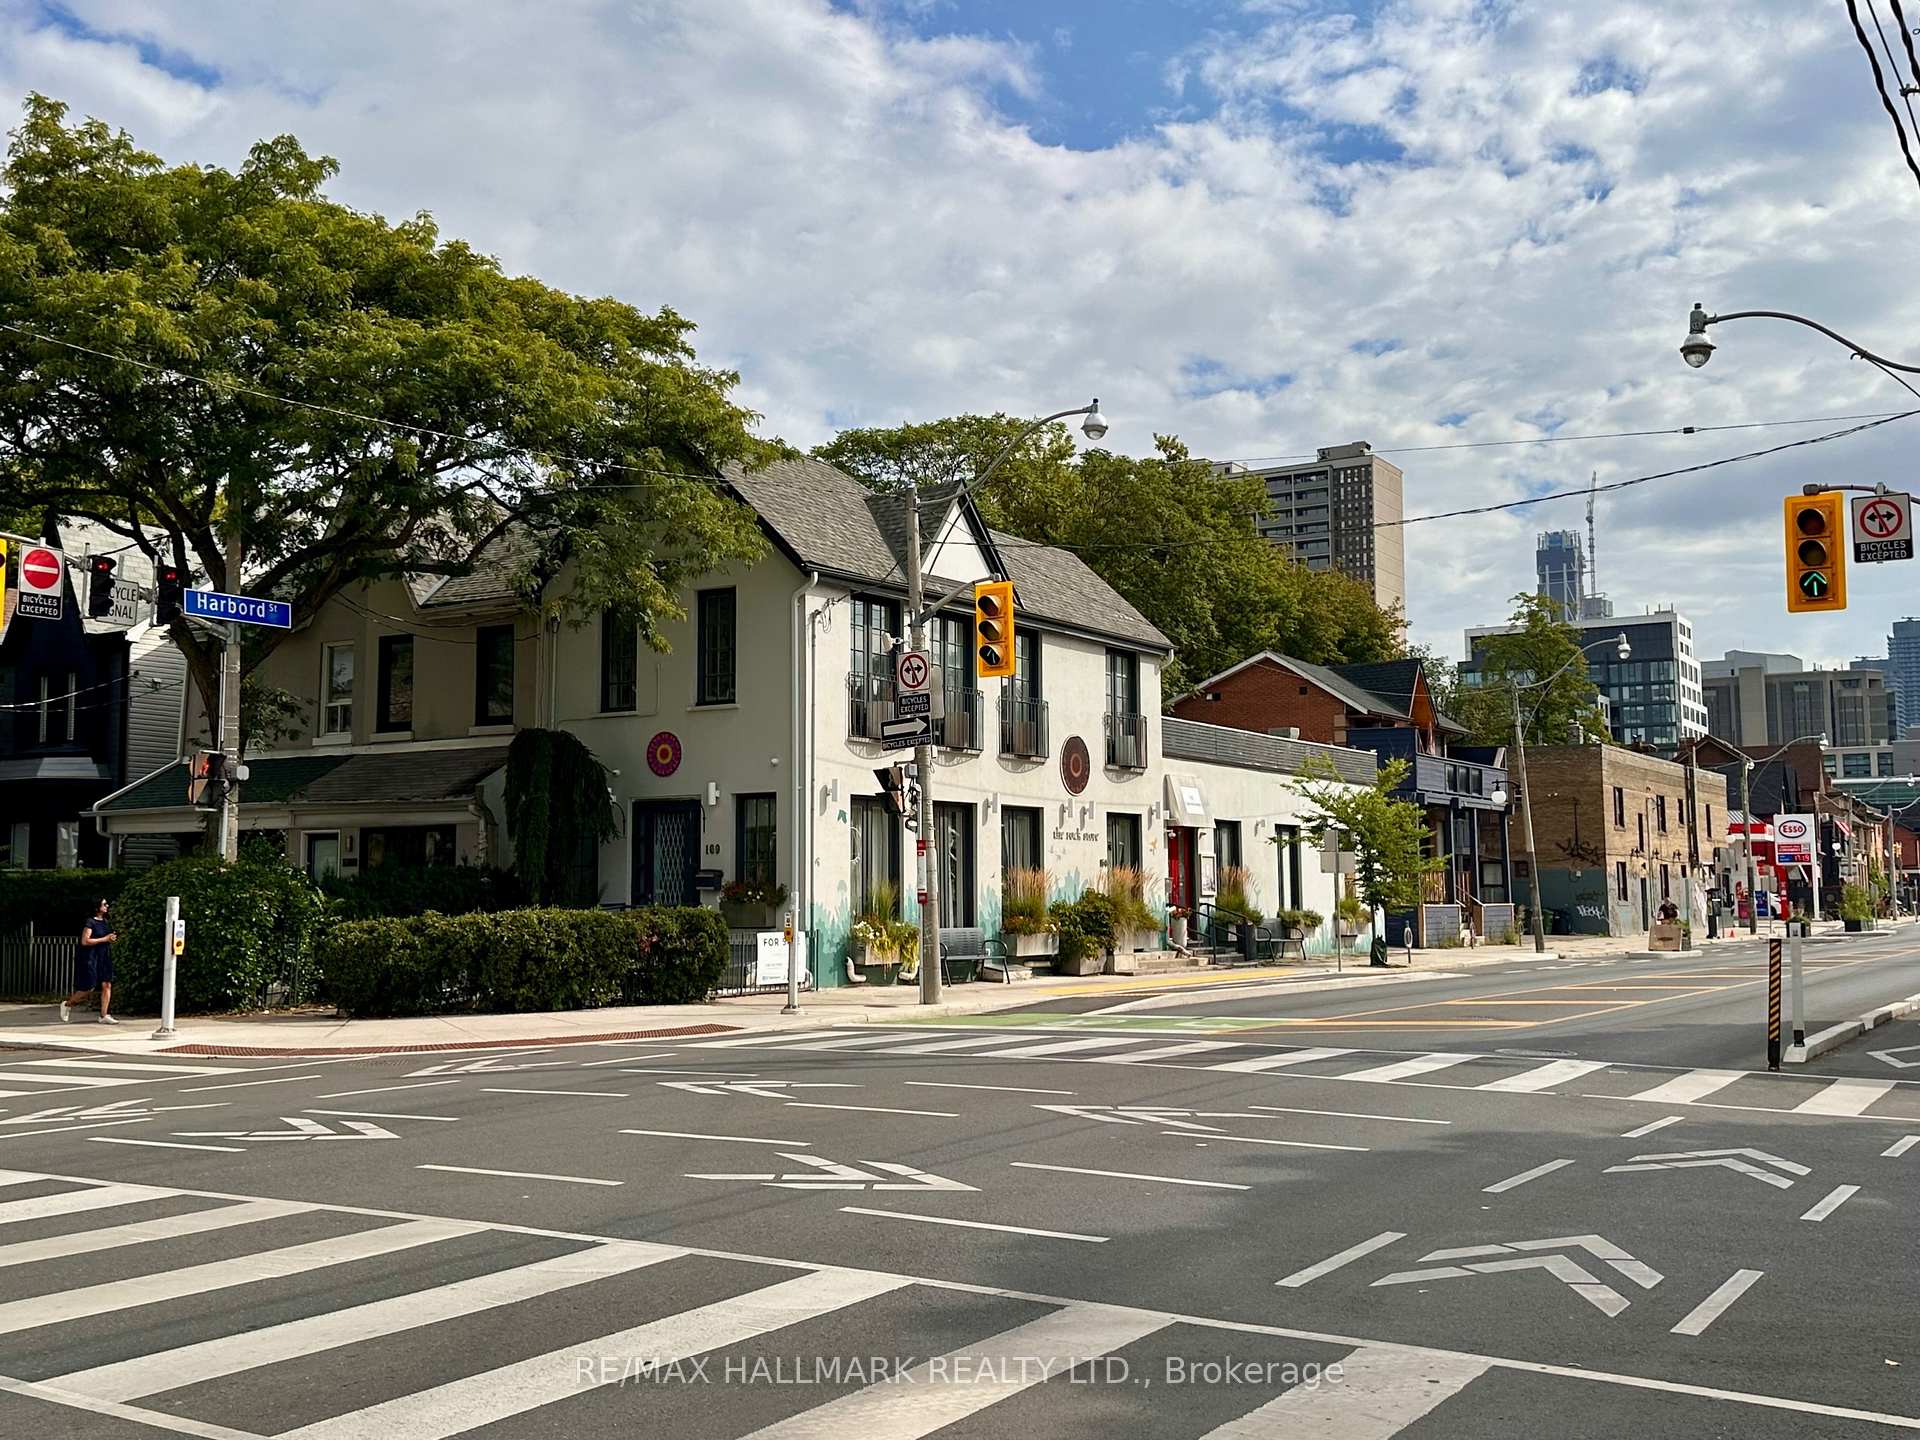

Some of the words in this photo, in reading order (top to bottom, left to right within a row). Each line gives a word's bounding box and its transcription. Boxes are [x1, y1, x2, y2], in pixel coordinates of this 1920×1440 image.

[1860, 541, 1906, 551] BICYCLES
[1860, 550, 1907, 560] EXCEPTED
[22, 595, 58, 606] BICYCLES
[197, 592, 265, 618] Harbord
[269, 603, 278, 612] St
[21, 605, 58, 616] EXCEPTED
[902, 696, 927, 705] BICYCLES
[901, 704, 928, 713] EXCEPTED
[763, 938, 779, 947] FOR
